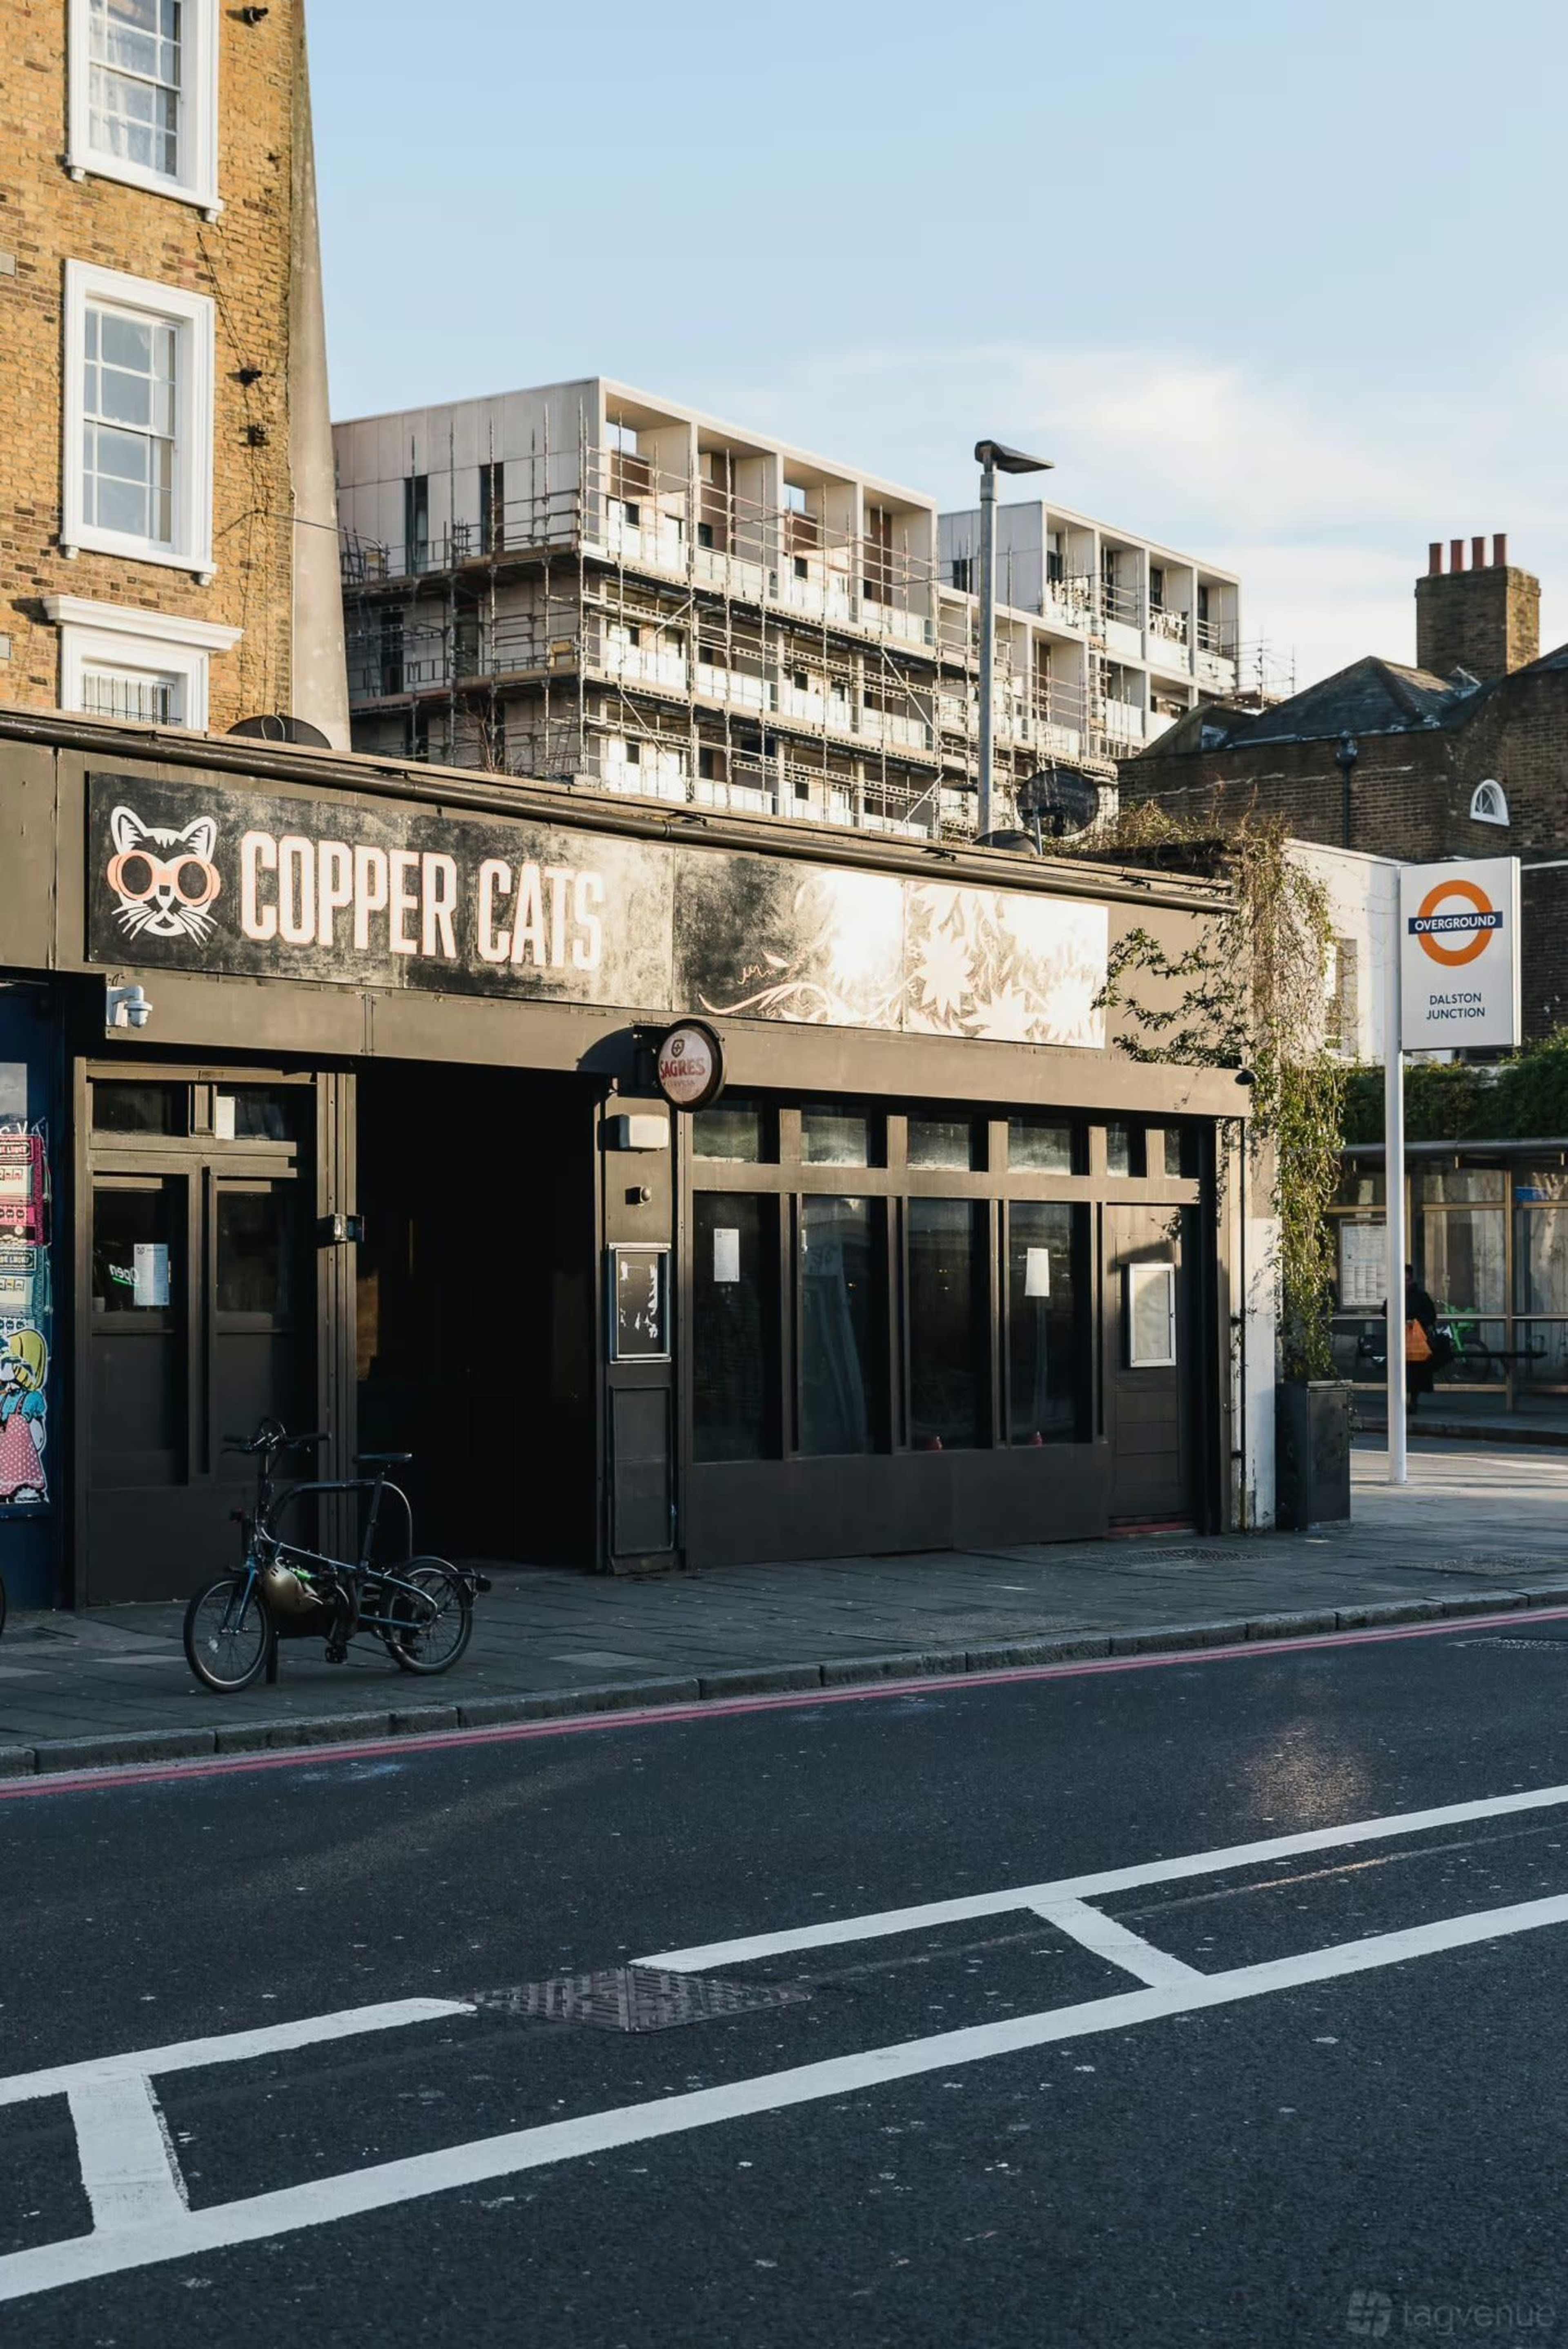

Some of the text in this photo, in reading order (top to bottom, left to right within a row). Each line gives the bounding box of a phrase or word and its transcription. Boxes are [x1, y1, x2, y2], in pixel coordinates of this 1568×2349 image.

[240, 830, 604, 971] COPPER CATS
[1414, 915, 1496, 931] OVERGROUND
[1430, 992, 1481, 1005] DALSTON
[1426, 1007, 1485, 1020] JUNCTION
[660, 1058, 706, 1080] SAGRES
